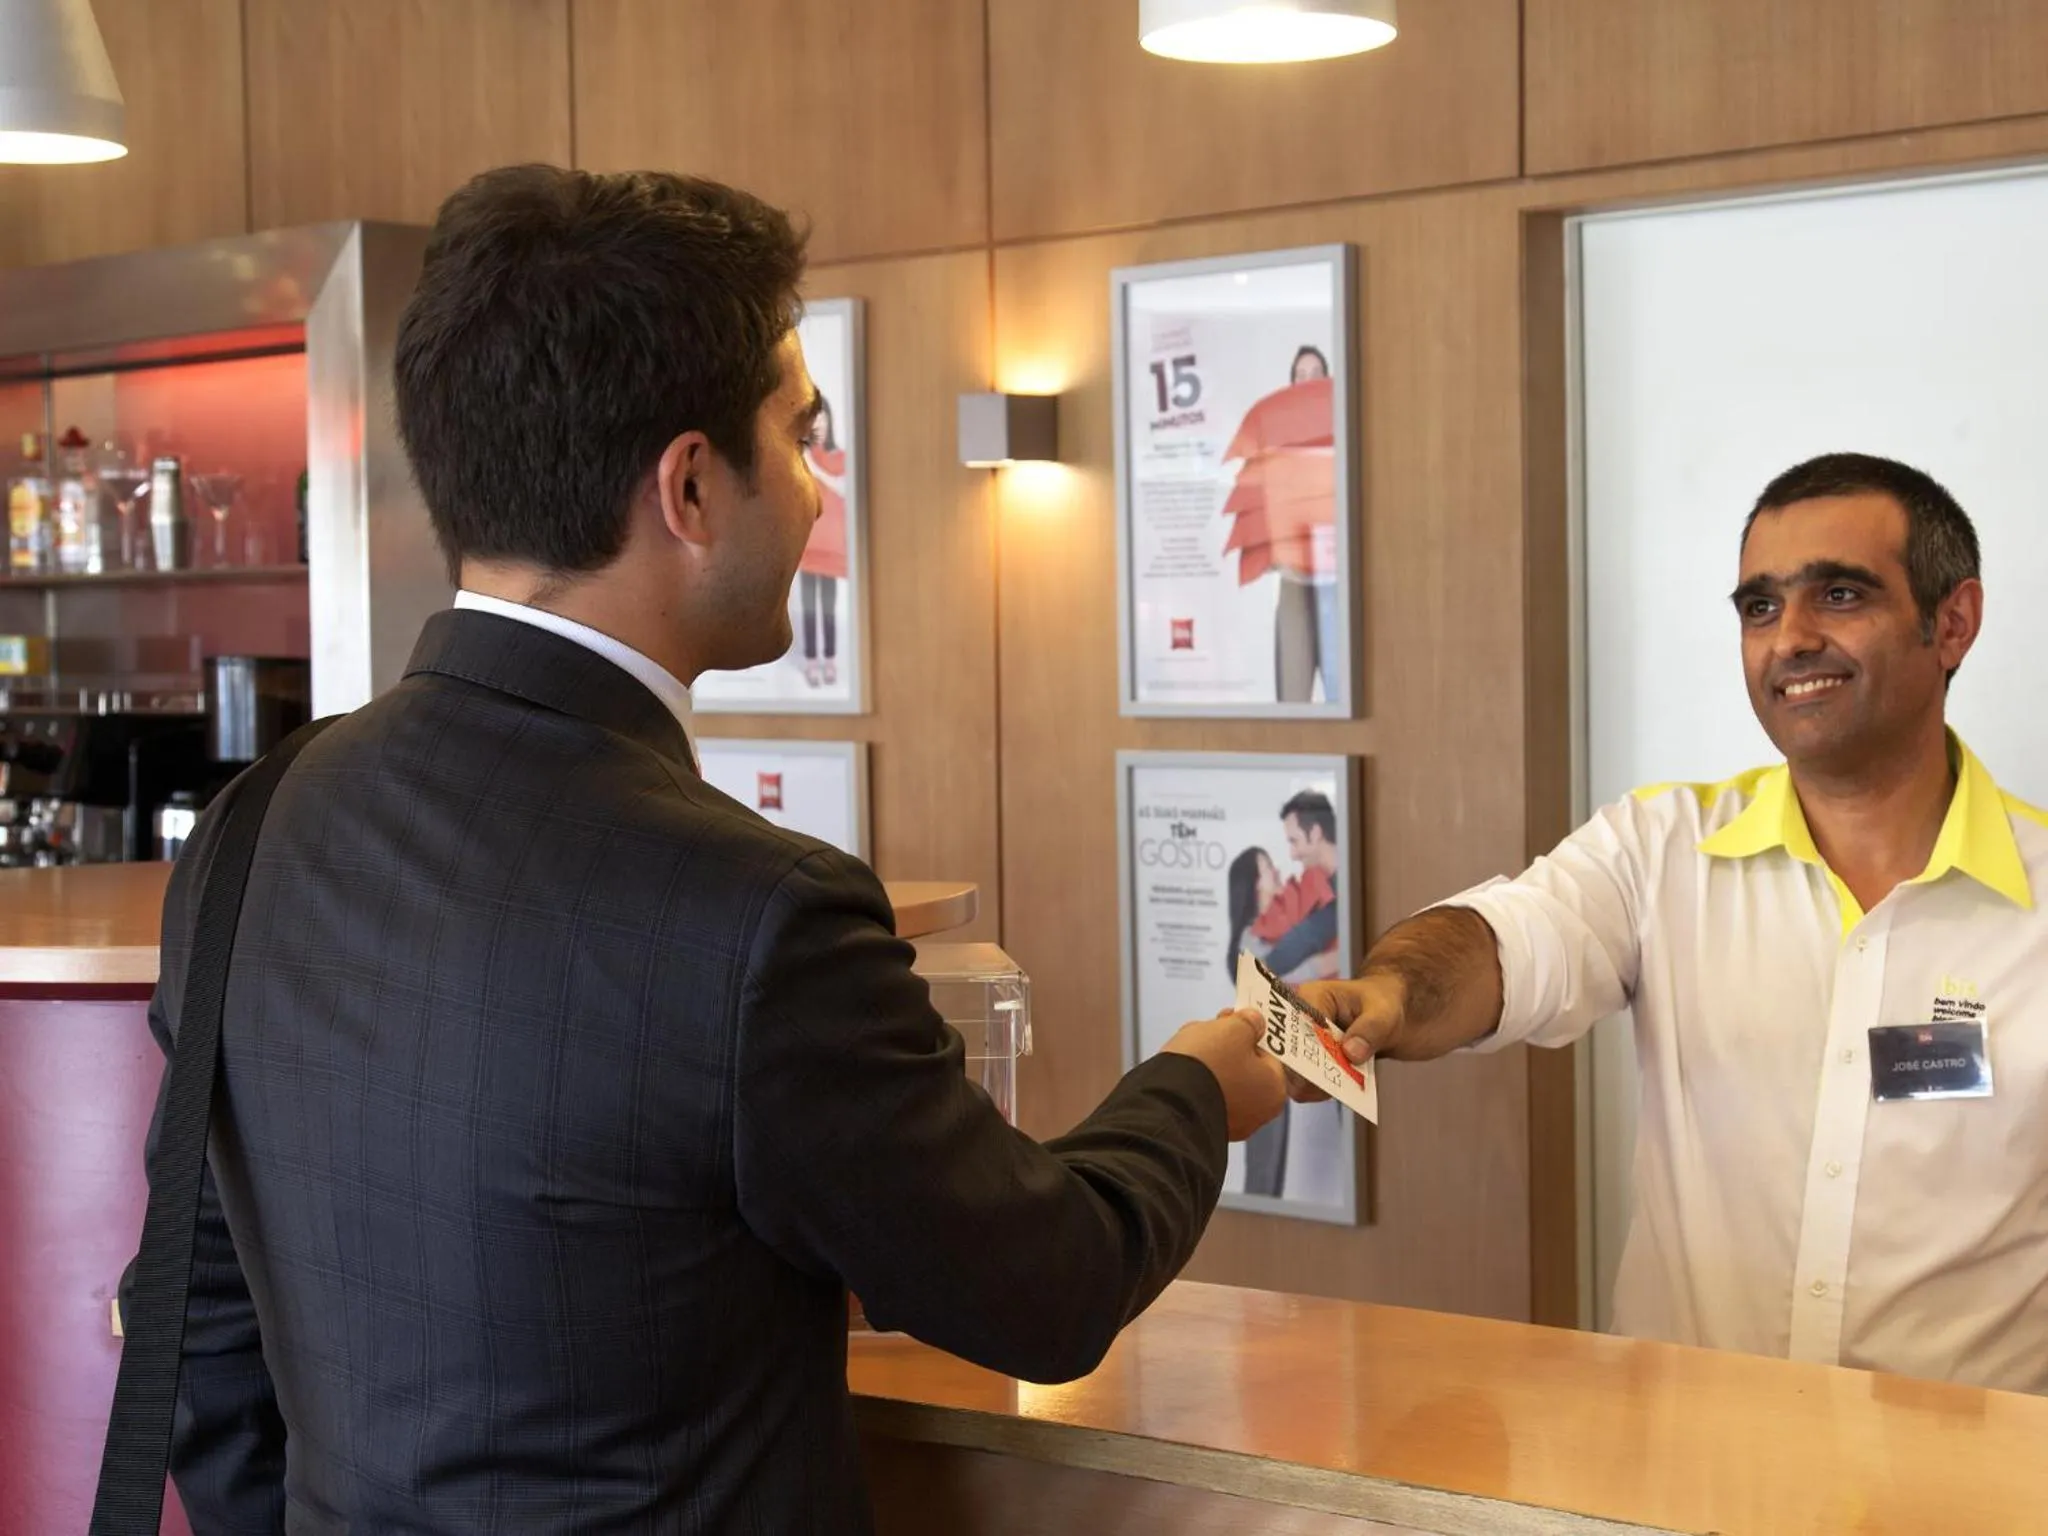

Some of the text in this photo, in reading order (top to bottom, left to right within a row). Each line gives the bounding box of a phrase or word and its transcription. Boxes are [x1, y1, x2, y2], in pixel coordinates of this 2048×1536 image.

[1149, 354, 1202, 413] 15
[1139, 838, 1228, 870] GOSTO
[1933, 1007, 1976, 1018] welcome
[1922, 1058, 1967, 1070] CASTRO
